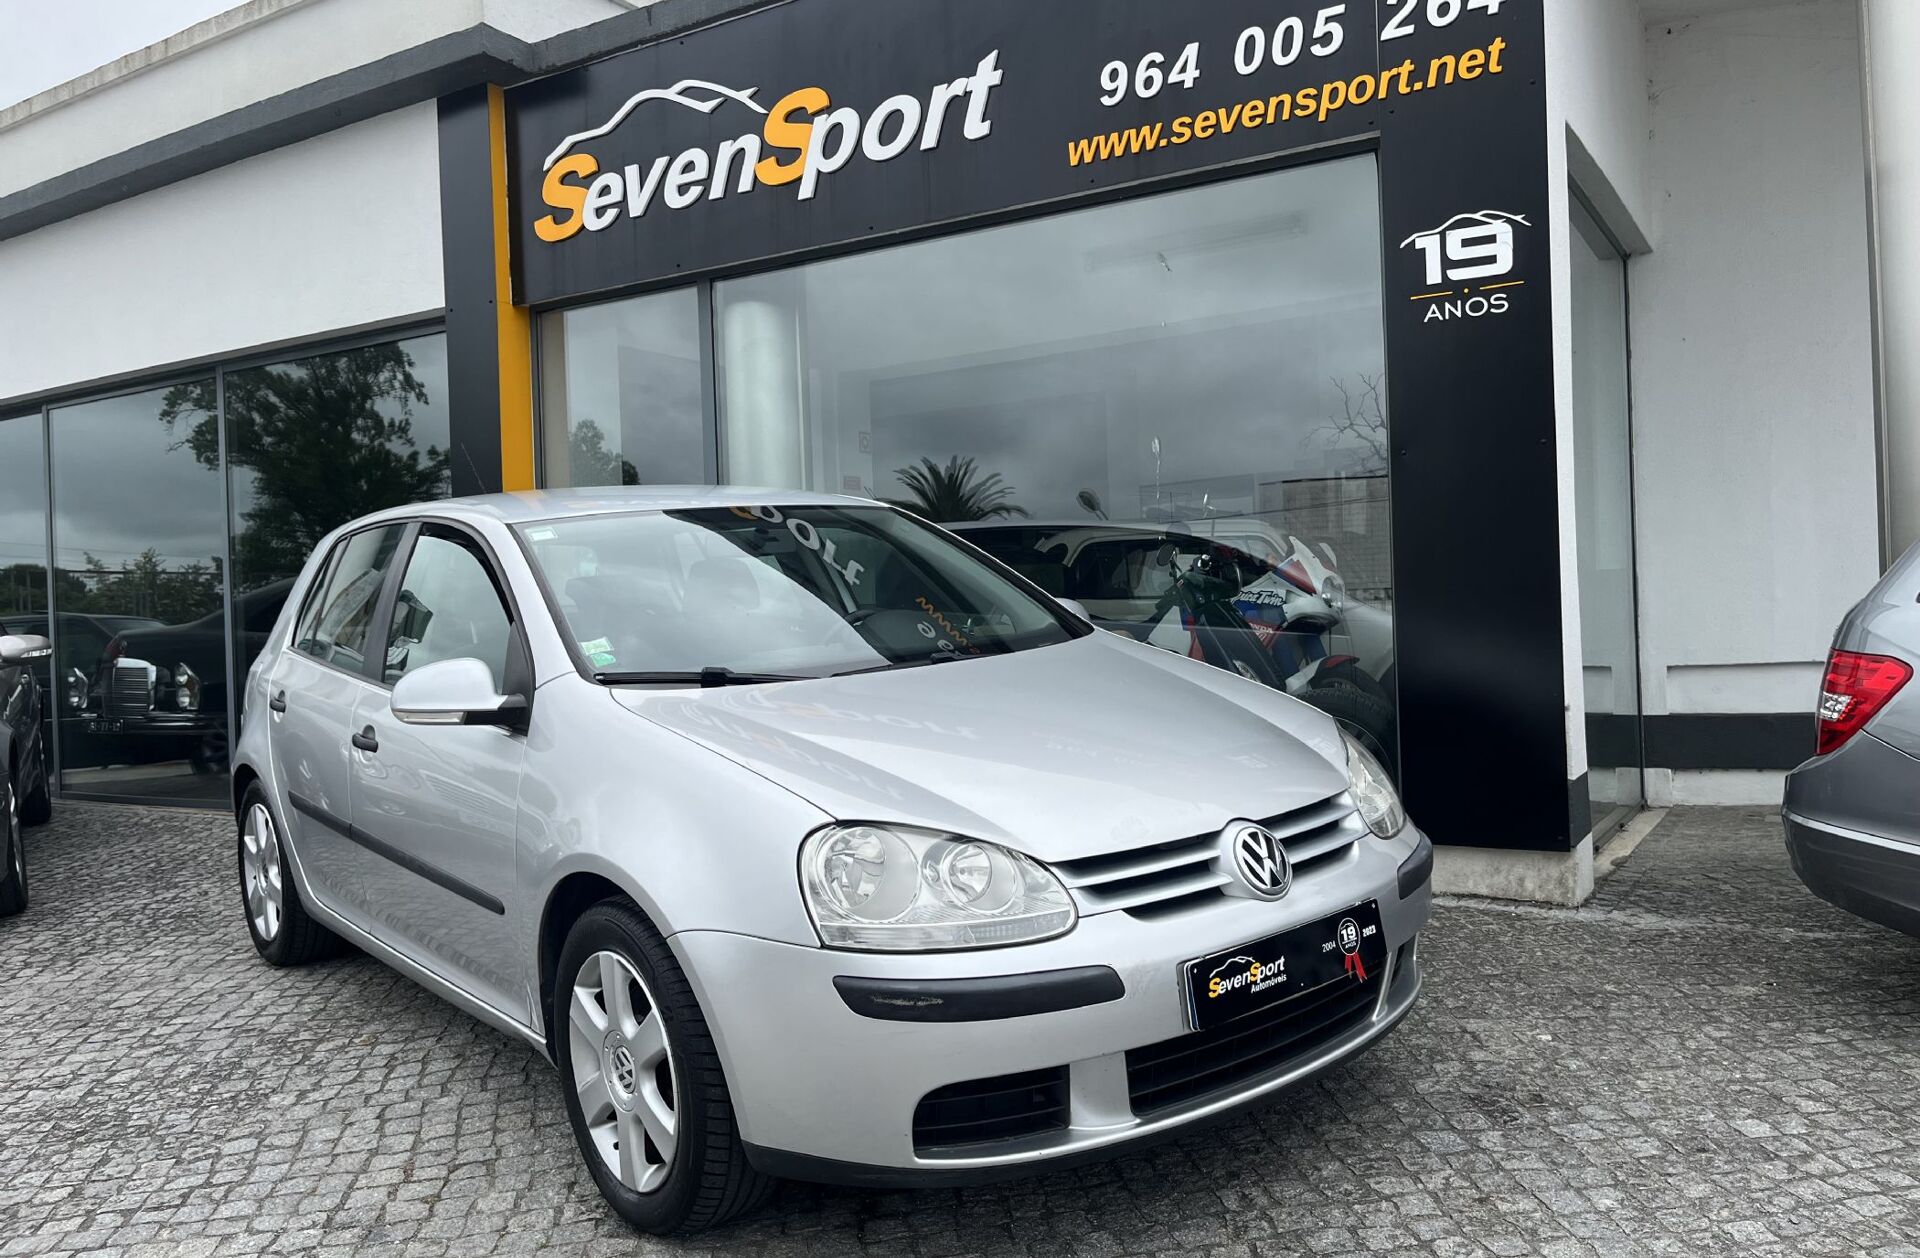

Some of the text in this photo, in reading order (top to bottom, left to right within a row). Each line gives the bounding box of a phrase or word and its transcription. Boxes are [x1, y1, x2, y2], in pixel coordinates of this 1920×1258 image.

[1100, 42, 1200, 106] 964
[1234, 4, 1345, 76] 005
[1068, 37, 1506, 166] www.sevensport.net
[534, 49, 1003, 242] SevenSport
[1415, 222, 1514, 285] 19
[1424, 293, 1509, 323] ANOS
[1321, 940, 1336, 952] 2004
[1340, 925, 1356, 942] 19
[1208, 955, 1285, 998] SevenSport
[1250, 973, 1287, 994] Automóveis
